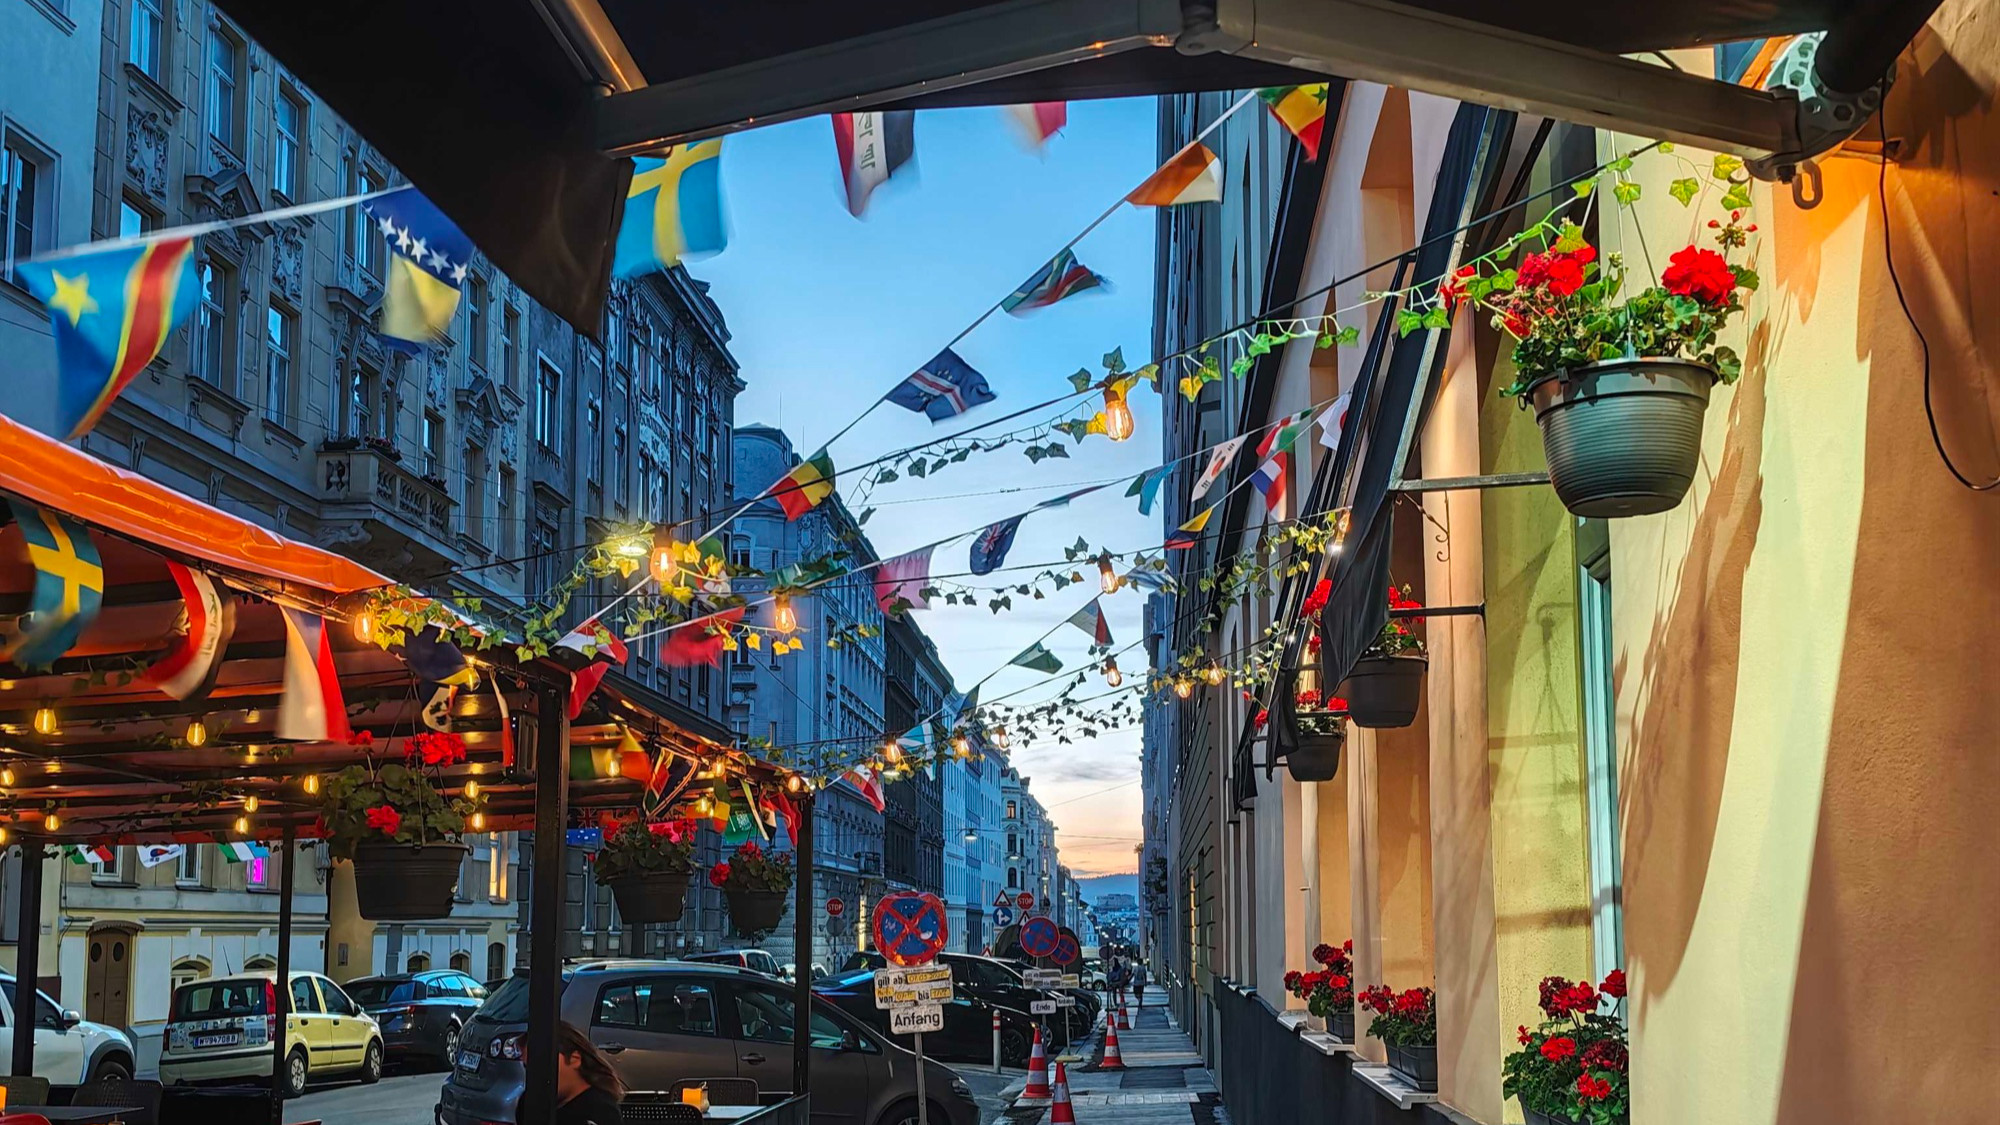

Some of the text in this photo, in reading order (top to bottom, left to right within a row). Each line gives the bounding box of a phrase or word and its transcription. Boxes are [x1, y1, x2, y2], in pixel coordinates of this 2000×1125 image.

[877, 976, 890, 988] gilt
[893, 974, 903, 984] ab
[918, 991, 930, 1000] bis
[894, 1012, 941, 1027] Anfang
